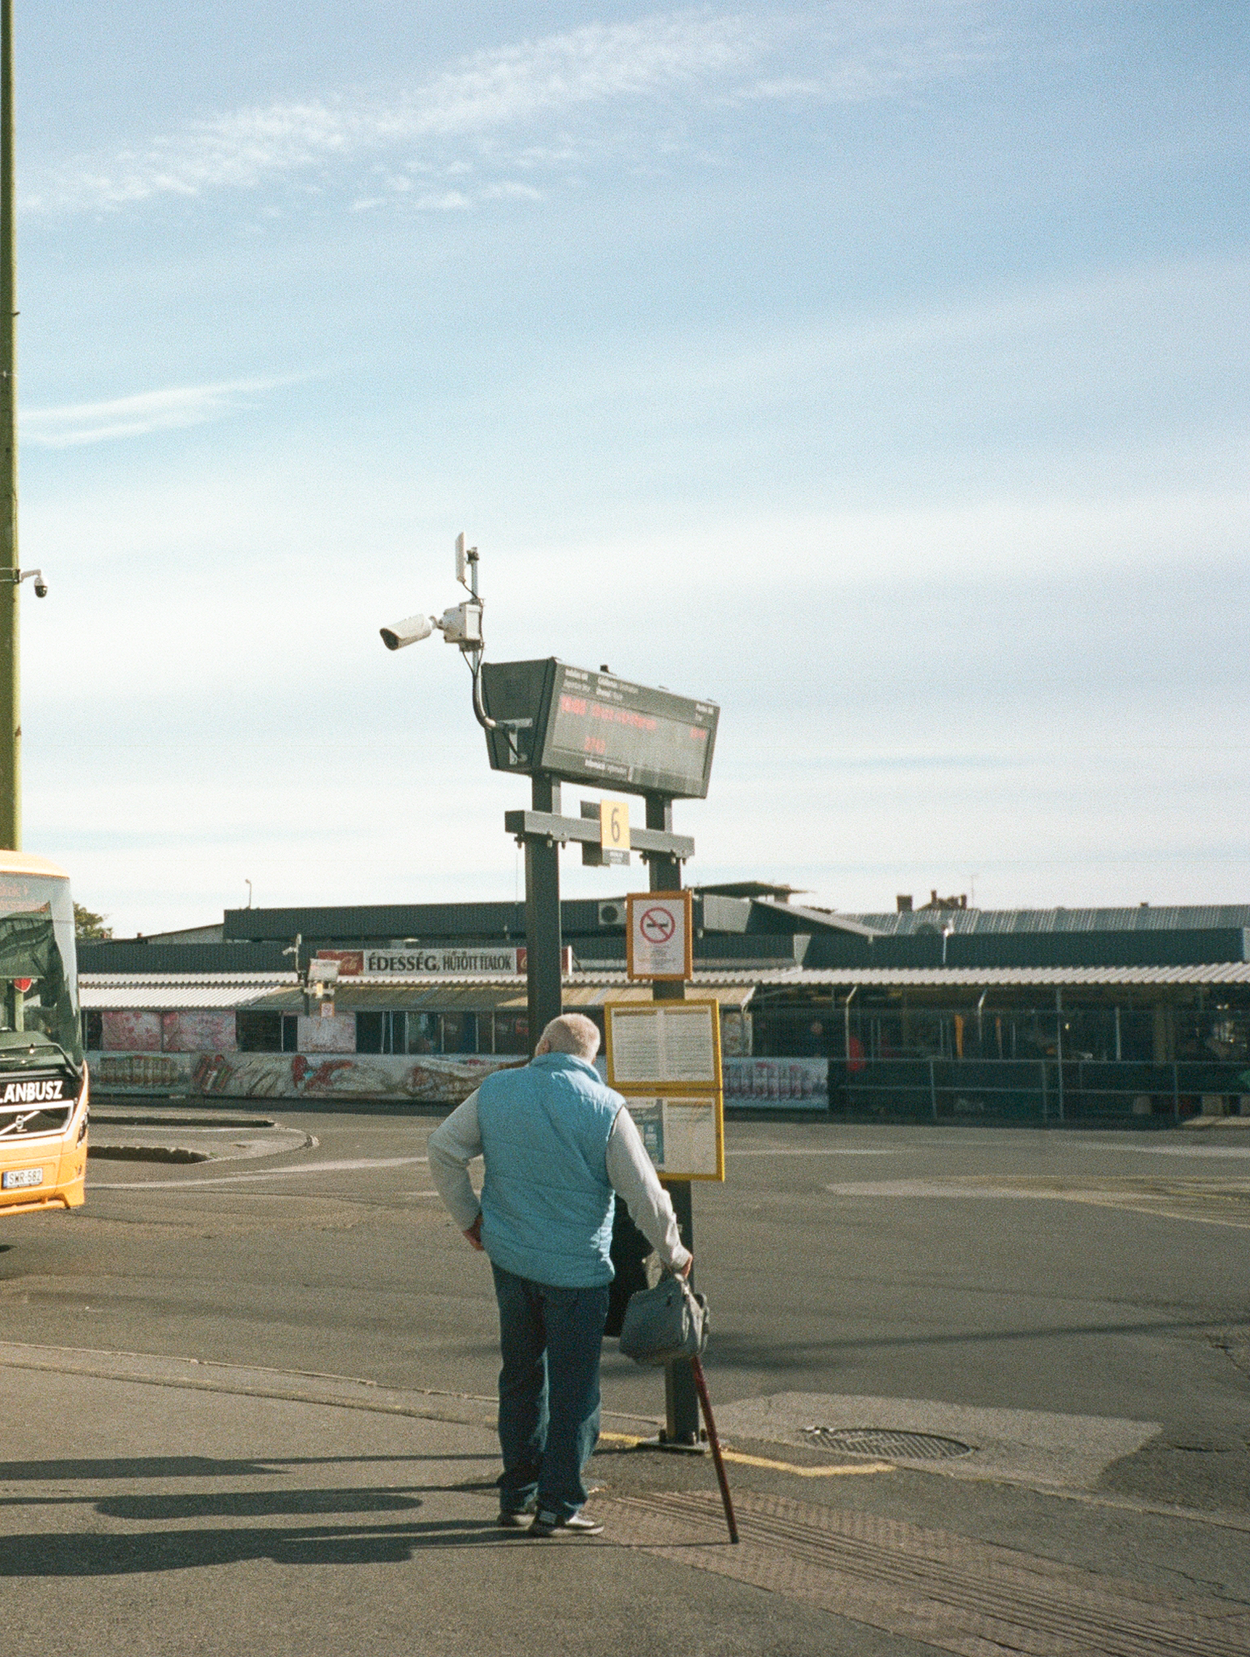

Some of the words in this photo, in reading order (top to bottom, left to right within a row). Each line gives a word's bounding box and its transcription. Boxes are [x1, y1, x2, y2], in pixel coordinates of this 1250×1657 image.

[610, 807, 621, 843] 6
[368, 952, 440, 972] ÉDESSÉG,
[9, 1170, 41, 1185] SWR-582
